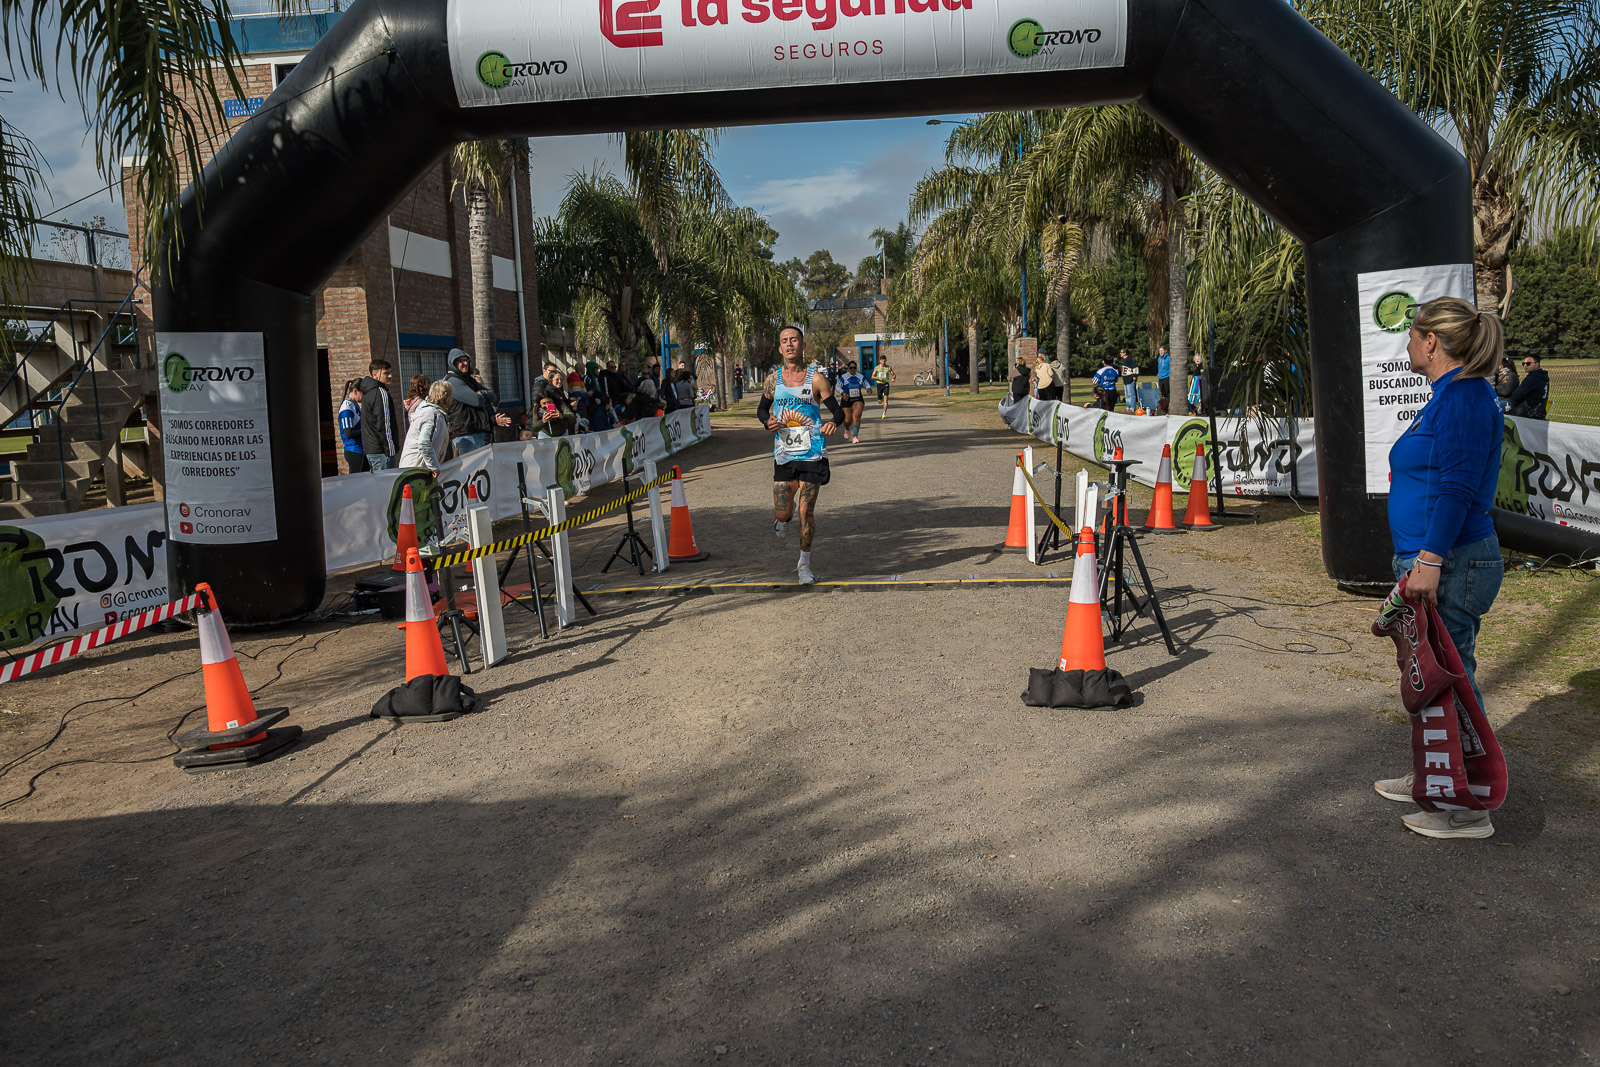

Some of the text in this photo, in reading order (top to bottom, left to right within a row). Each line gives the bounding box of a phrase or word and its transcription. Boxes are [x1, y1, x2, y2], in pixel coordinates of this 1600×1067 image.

[1033, 28, 1102, 46] CRONO
[774, 39, 884, 61] SEGUROS
[1032, 47, 1056, 57] RAV
[502, 60, 568, 78] CRONO
[503, 79, 526, 87] RAV
[1376, 361, 1411, 373] “SOMO
[182, 367, 254, 382] CRONO
[182, 384, 204, 392] RAV
[1369, 376, 1423, 390] BUSCANDO
[1379, 392, 1433, 406] EXPERIENC
[195, 419, 255, 430] CORREDORES
[165, 433, 264, 446] BUSCANDO MEJORAR LAS
[785, 433, 803, 446] 64
[170, 450, 256, 461] EXPERIENCIAS DE LOS
[194, 506, 252, 518] Cronorav
[196, 523, 252, 534] Cronorav
[26, 602, 80, 640] RAV
